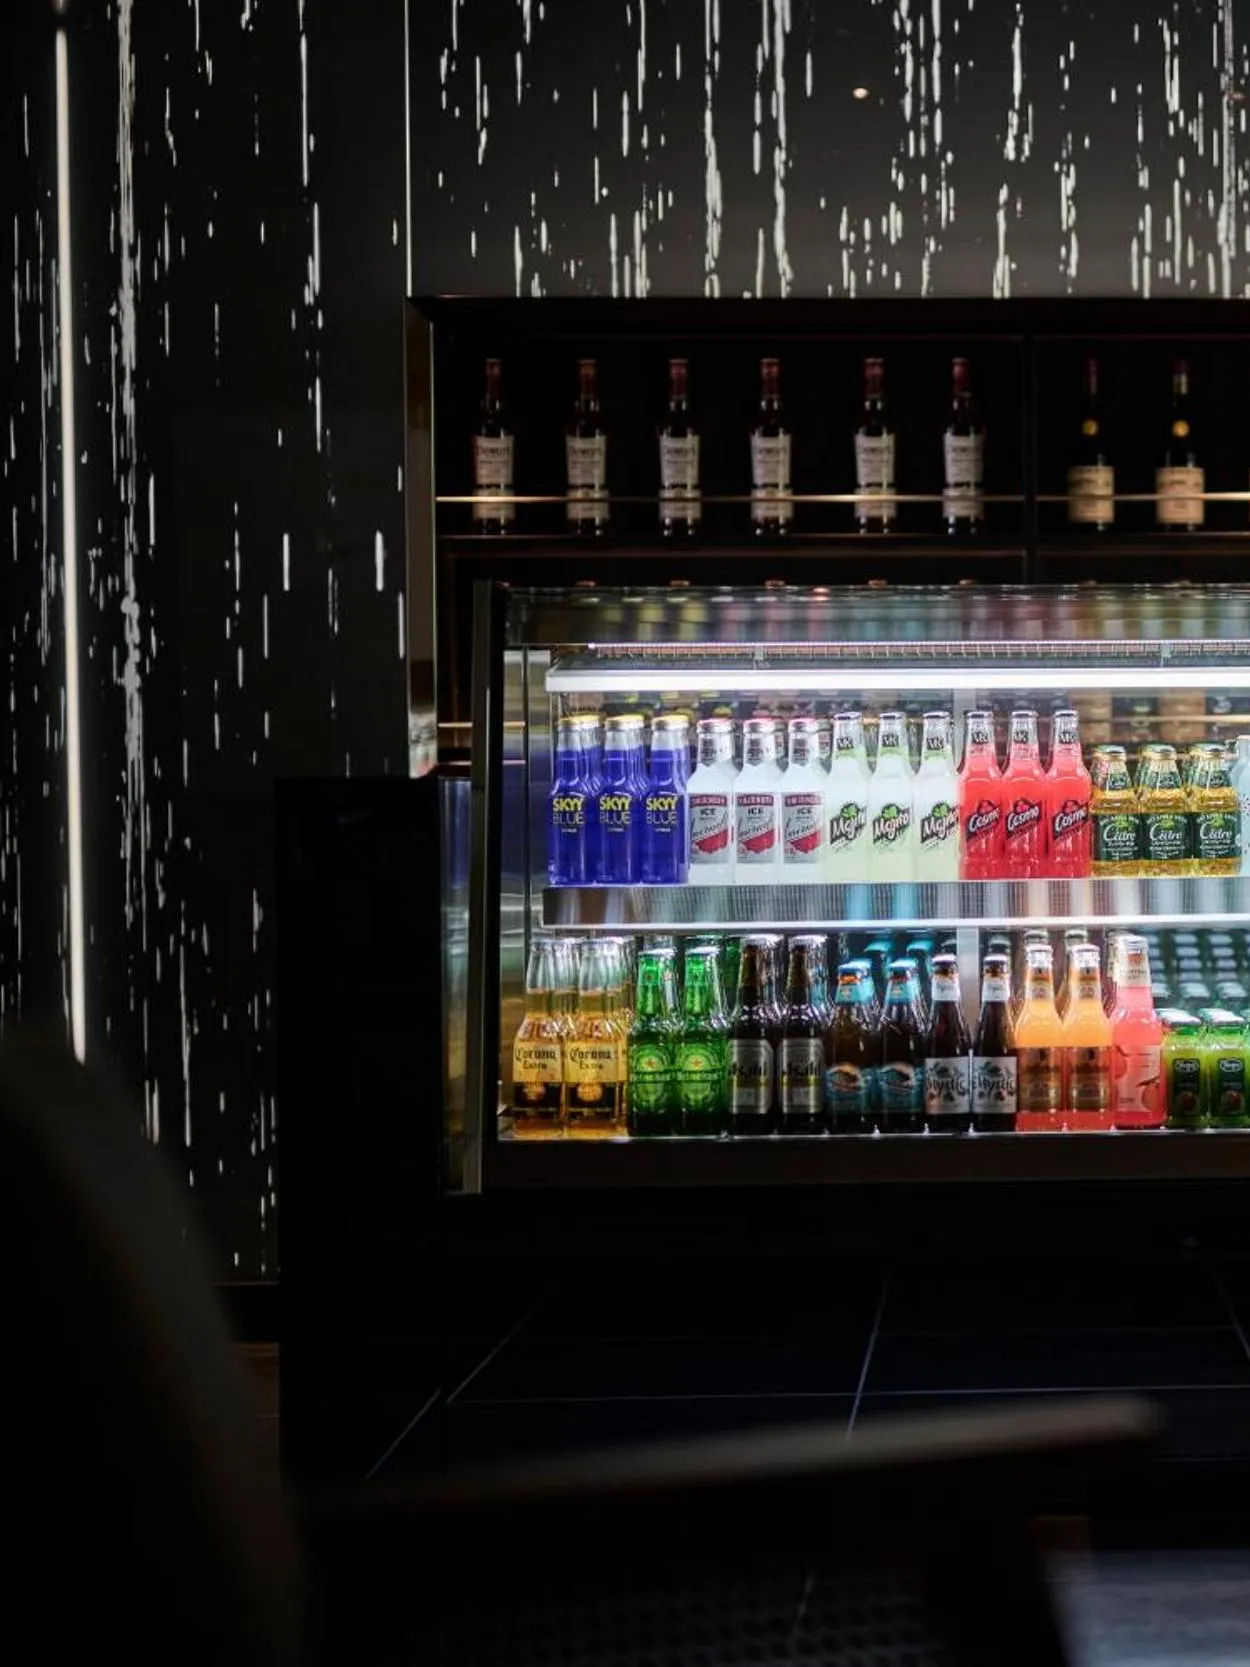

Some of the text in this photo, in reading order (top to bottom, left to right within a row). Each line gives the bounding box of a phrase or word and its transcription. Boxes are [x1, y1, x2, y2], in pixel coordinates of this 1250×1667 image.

[553, 797, 584, 811] SKYY
[600, 796, 631, 811] SKYY
[646, 796, 678, 811] SKYY
[553, 811, 584, 824] BLUE
[600, 811, 631, 824] BLUE
[646, 811, 677, 824] BLUE
[1007, 806, 1040, 831] Cosmo
